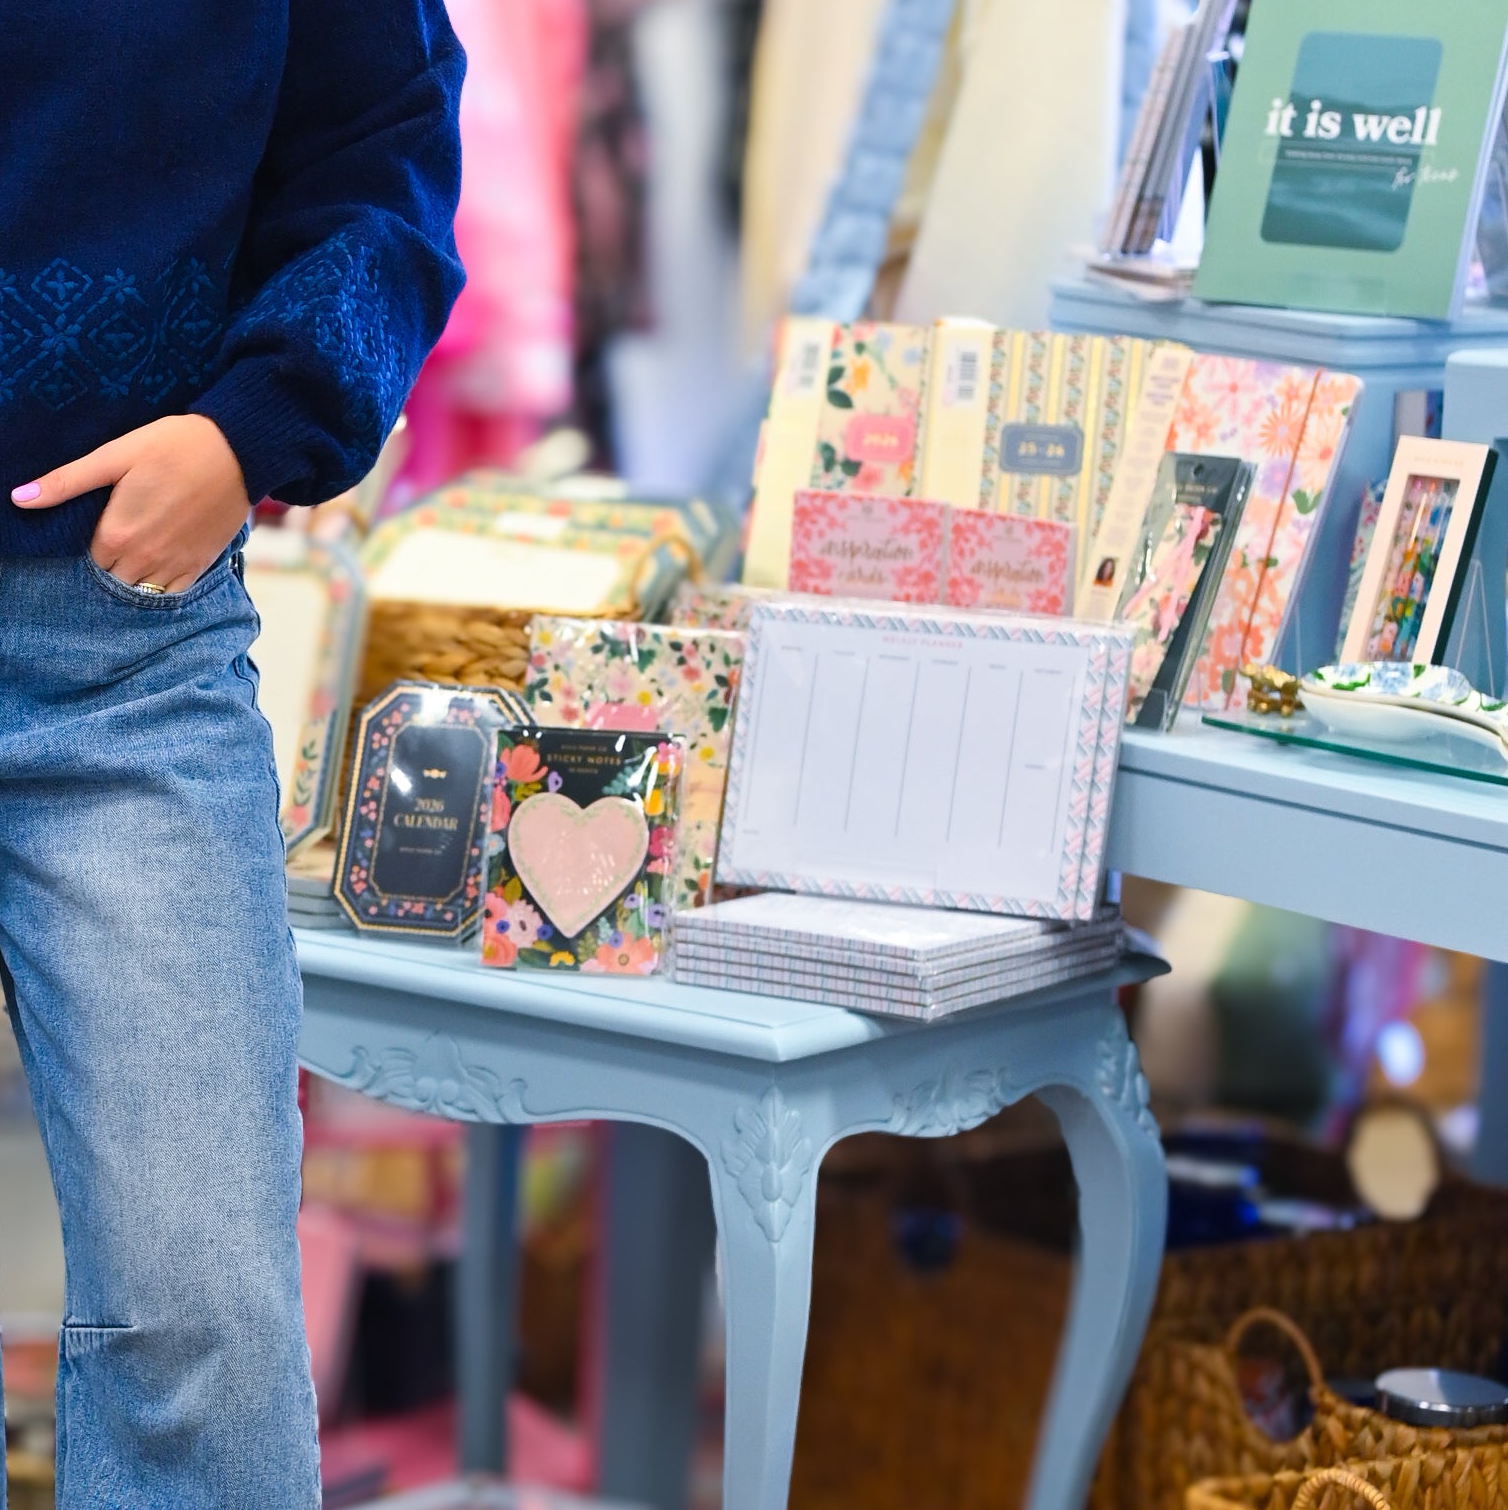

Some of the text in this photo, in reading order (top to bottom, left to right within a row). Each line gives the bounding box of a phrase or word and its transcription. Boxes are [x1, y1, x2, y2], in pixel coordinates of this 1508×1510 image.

[1265, 97, 1442, 146] it is well
[547, 753, 622, 767] STICKY NOTES
[393, 813, 459, 831] CALENDAR
